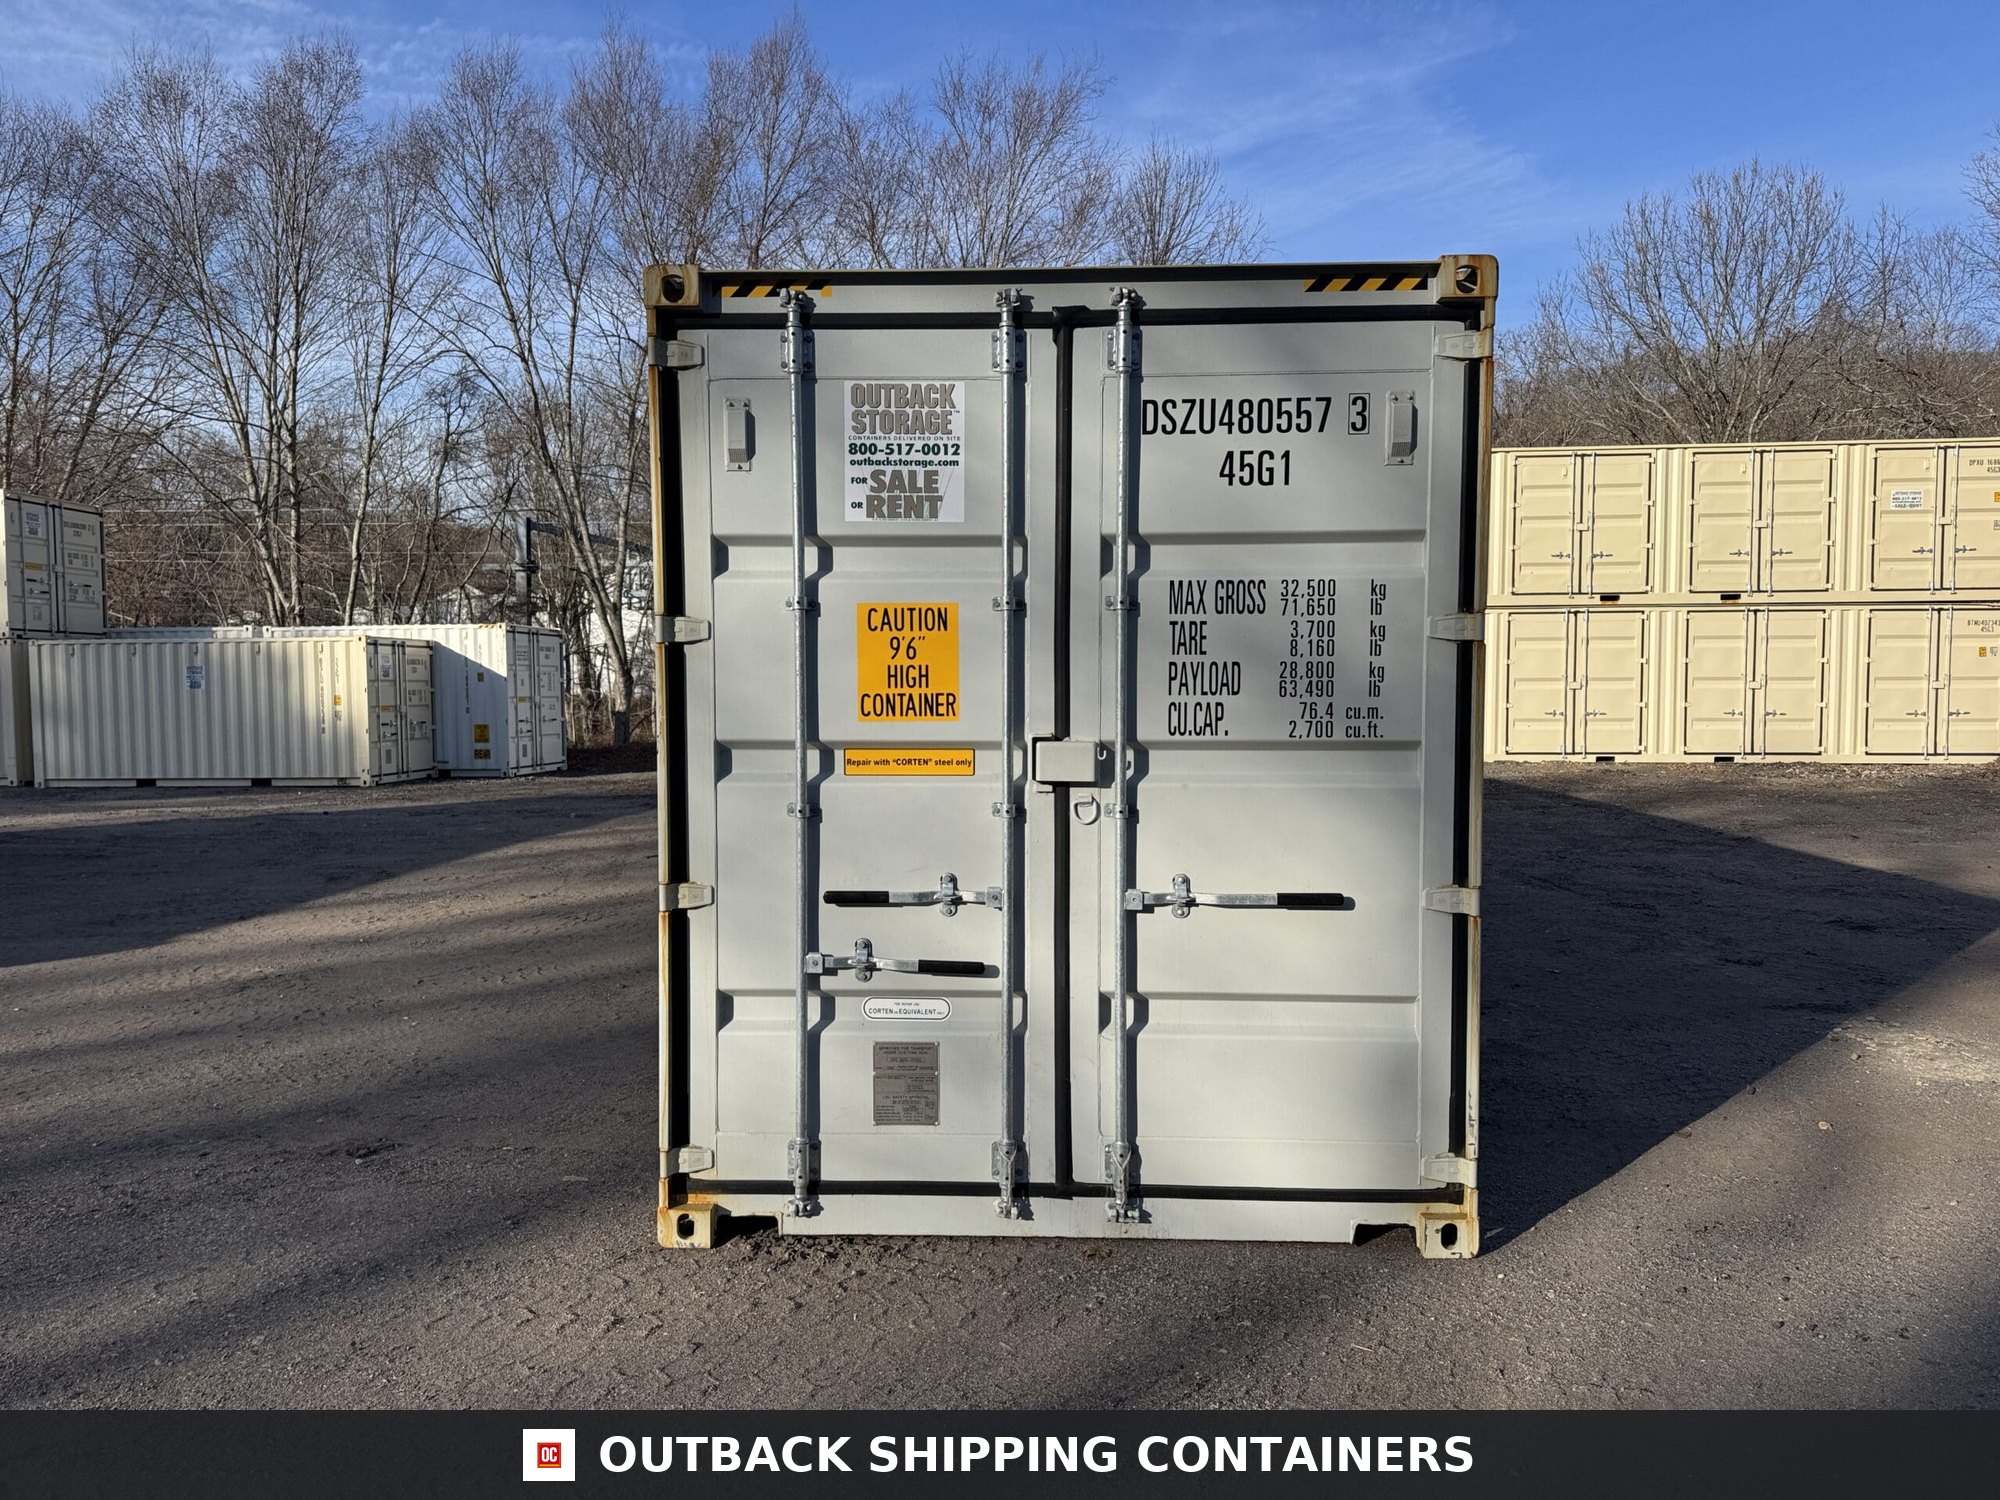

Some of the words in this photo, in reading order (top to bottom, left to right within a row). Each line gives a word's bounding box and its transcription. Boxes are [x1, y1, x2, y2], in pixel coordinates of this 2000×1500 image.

[850, 383, 956, 409] OUTBACK
[1141, 396, 1332, 436] DSZU480557
[1350, 395, 1369, 432] 3
[848, 443, 961, 456] 800-517-0012
[849, 457, 959, 468] outbackstorage.com
[1219, 449, 1291, 487] 45G1
[851, 477, 868, 485] FOR
[870, 469, 939, 494] SALE
[866, 494, 943, 519] RENT
[1169, 579, 1207, 615] MAX
[1214, 579, 1266, 615] GROSS
[1280, 579, 1336, 599] 32,500
[1370, 579, 1386, 601] kg
[1281, 598, 1336, 617] 71,650
[1370, 598, 1383, 616] lb
[867, 607, 948, 632] CAUTION
[1290, 620, 1336, 640] 3,700
[1370, 620, 1386, 642] kg
[1169, 620, 1208, 656] TARE
[1290, 638, 1335, 658] 8,160
[1370, 638, 1382, 657] lb
[887, 664, 930, 689] HIGH
[1168, 661, 1241, 696] PAYLOAD
[1279, 661, 1335, 680] 28,800
[1369, 661, 1385, 683] kg
[1278, 680, 1334, 699] 63,490
[1368, 680, 1380, 698] lb
[860, 693, 957, 718] CONTAINER
[1299, 702, 1334, 720] 76.4
[1345, 704, 1384, 720] cu.m.
[1168, 701, 1229, 736] CU.CAP.
[1288, 720, 1334, 740] 2,700
[1345, 721, 1384, 739] cu.ft.
[847, 758, 872, 767] Repair
[874, 758, 890, 766] with
[934, 758, 954, 766] steel
[956, 758, 972, 768] only
[898, 1008, 936, 1016] EQUIVALENT
